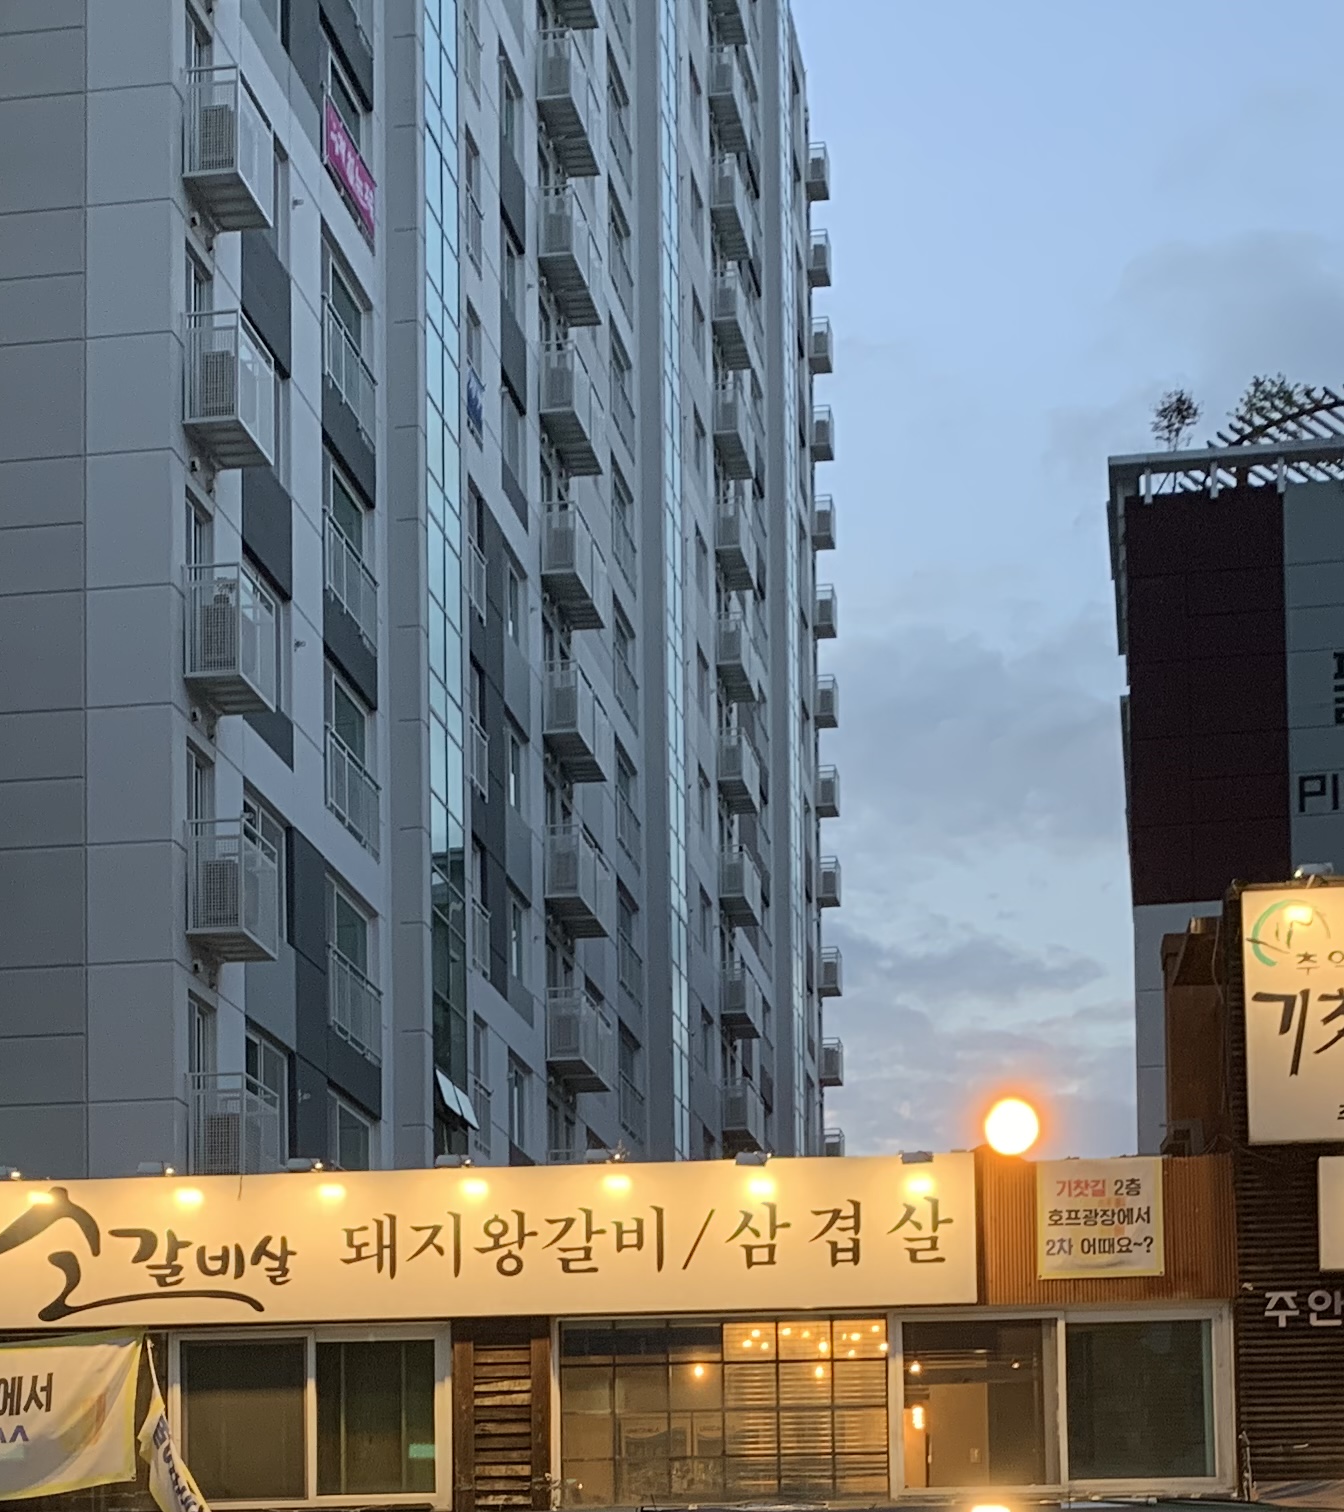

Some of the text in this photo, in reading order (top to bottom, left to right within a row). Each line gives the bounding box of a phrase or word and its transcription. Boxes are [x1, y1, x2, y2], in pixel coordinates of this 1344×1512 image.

[1056, 1177, 1142, 1198] 기찻길 2층
[1047, 1205, 1152, 1227] 호프광장에서
[1045, 1235, 1155, 1256] 2차 어때요~?
